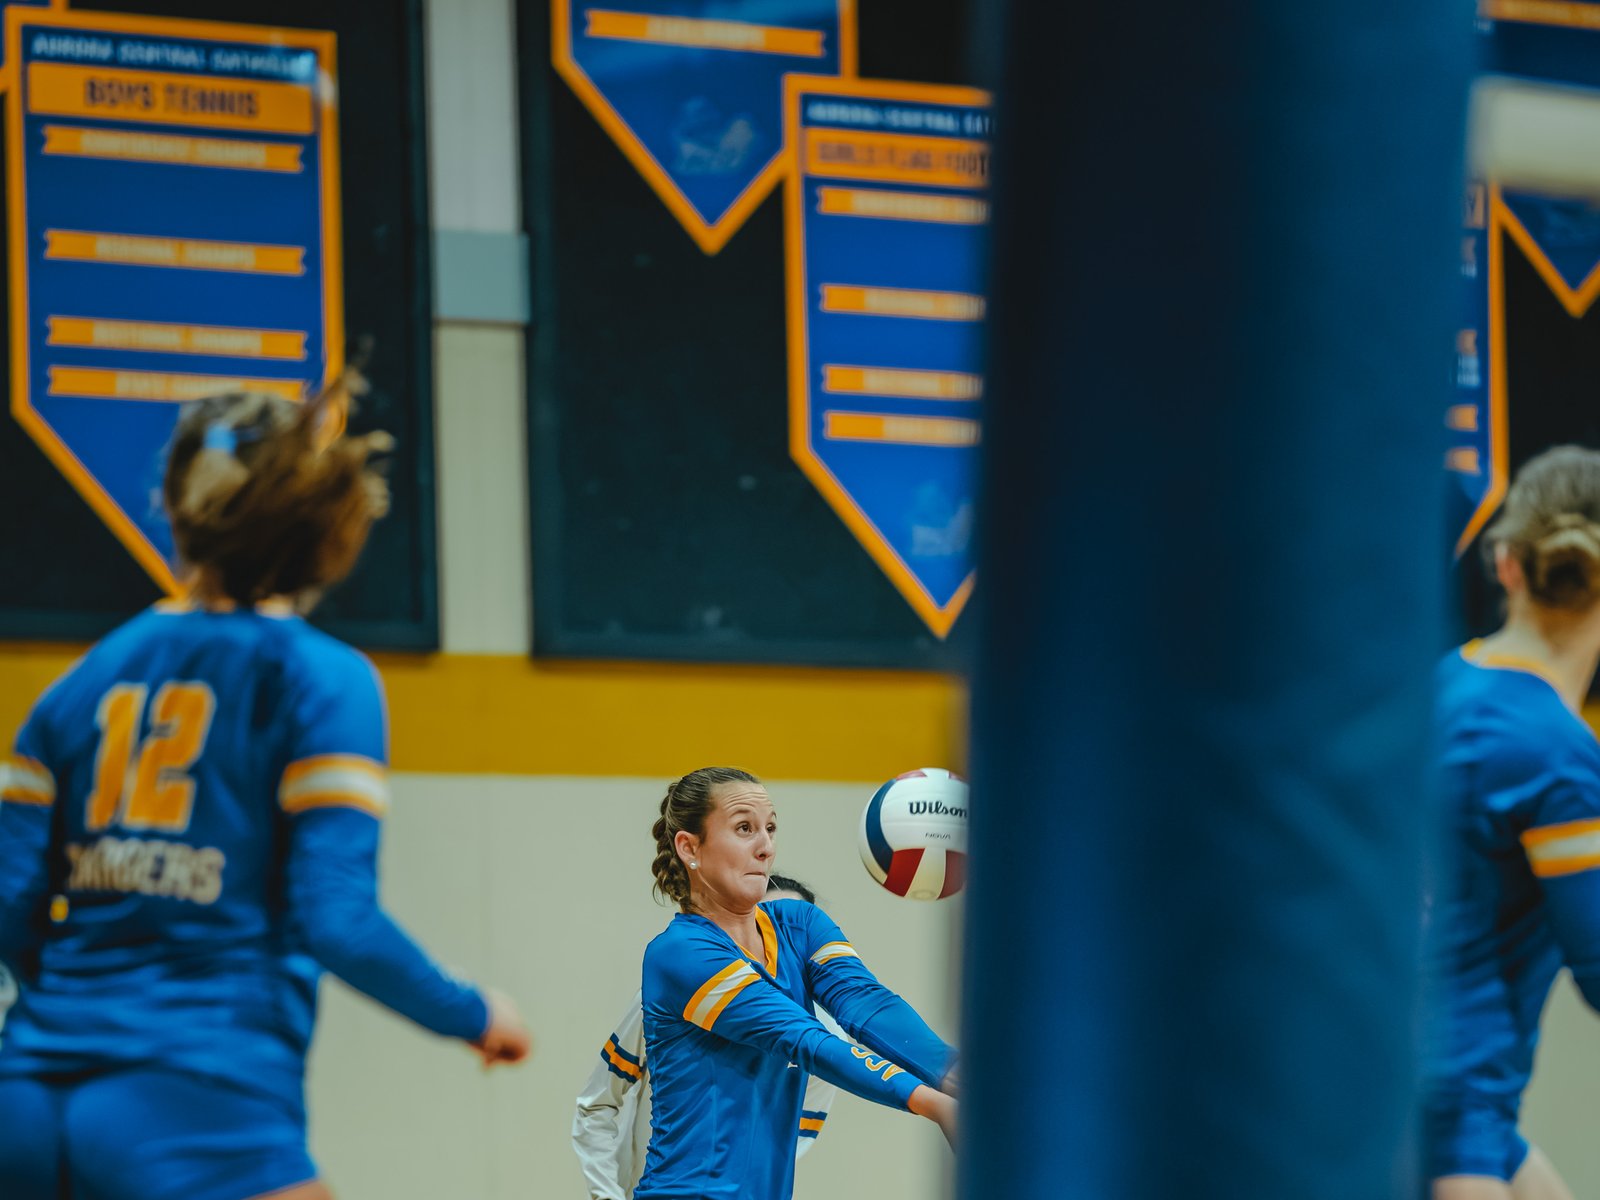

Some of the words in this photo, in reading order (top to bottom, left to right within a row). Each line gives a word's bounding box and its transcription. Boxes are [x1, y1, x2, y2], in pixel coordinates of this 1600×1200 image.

[85, 78, 154, 109] BOYS
[163, 84, 259, 118] TENNIS
[85, 681, 216, 832] 12
[909, 800, 967, 819] Wilson
